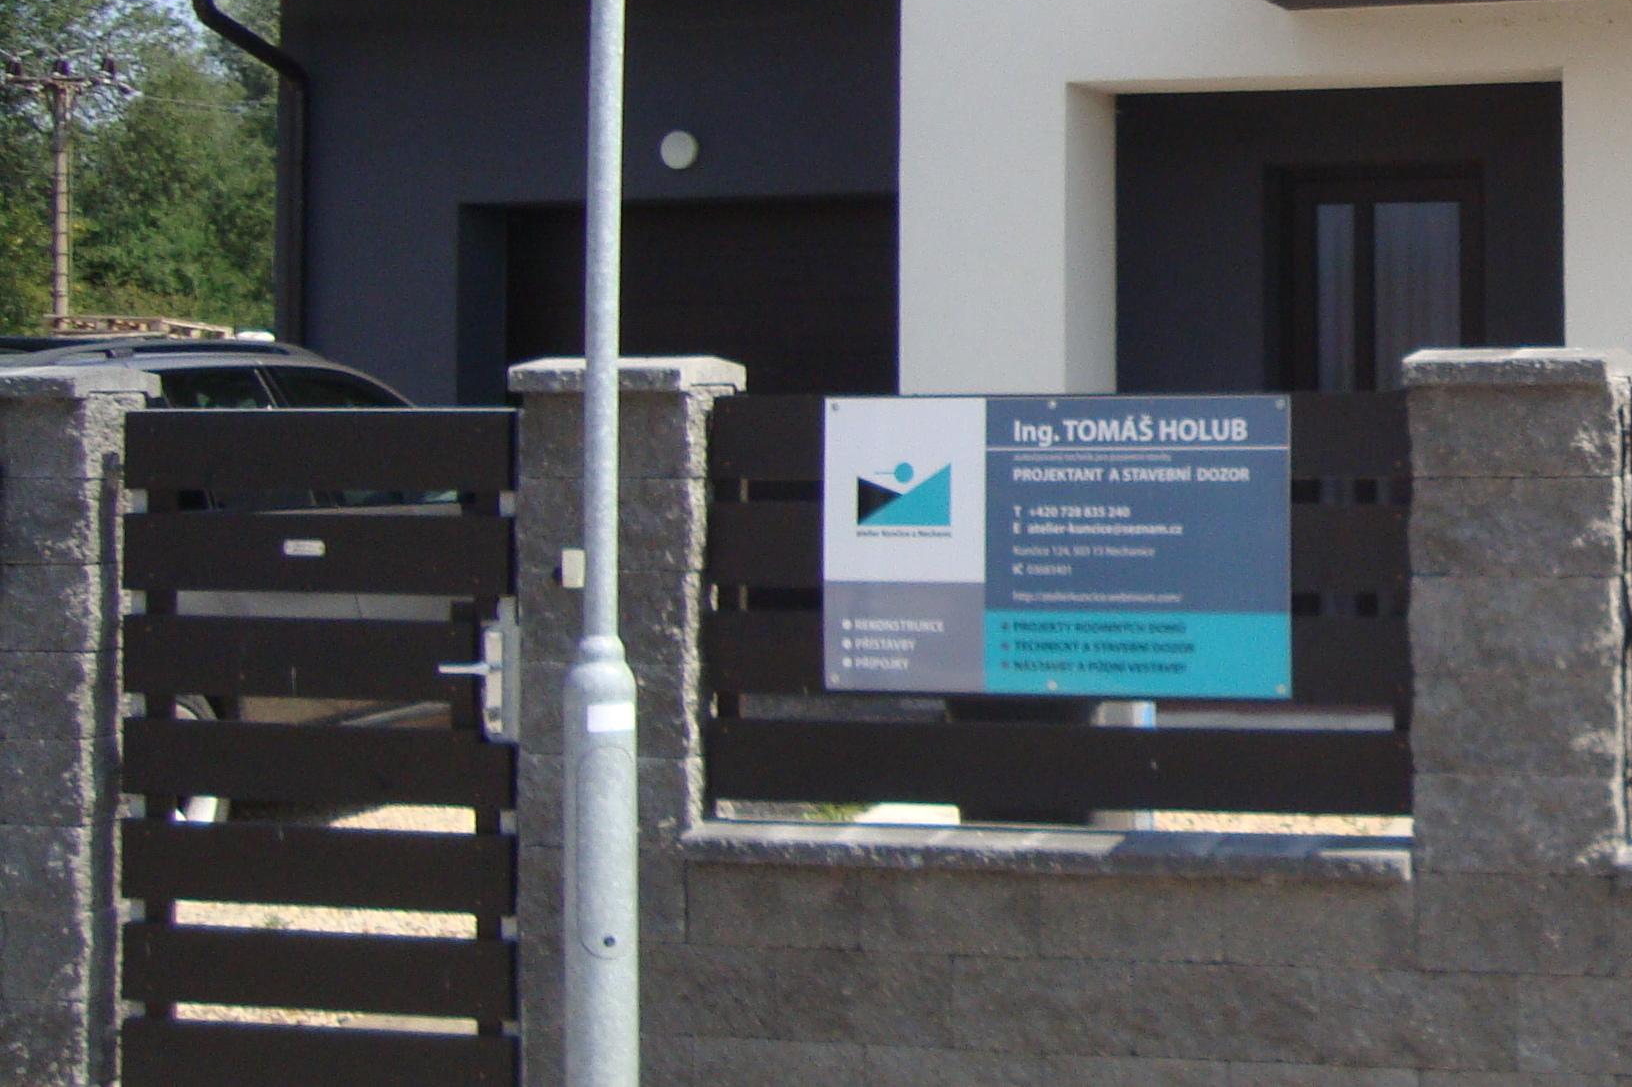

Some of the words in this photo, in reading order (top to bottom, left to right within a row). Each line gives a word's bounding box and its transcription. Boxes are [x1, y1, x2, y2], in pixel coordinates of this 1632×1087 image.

[1013, 420, 1060, 447] Ing.
[1063, 415, 1153, 442] TOMÁŠ
[1159, 419, 1248, 441] HOLUB
[1013, 467, 1103, 481] PROJEKTANT
[1109, 467, 1119, 481] A
[1122, 465, 1191, 481] STAVEBNÍ
[1197, 467, 1249, 481] DOZOR
